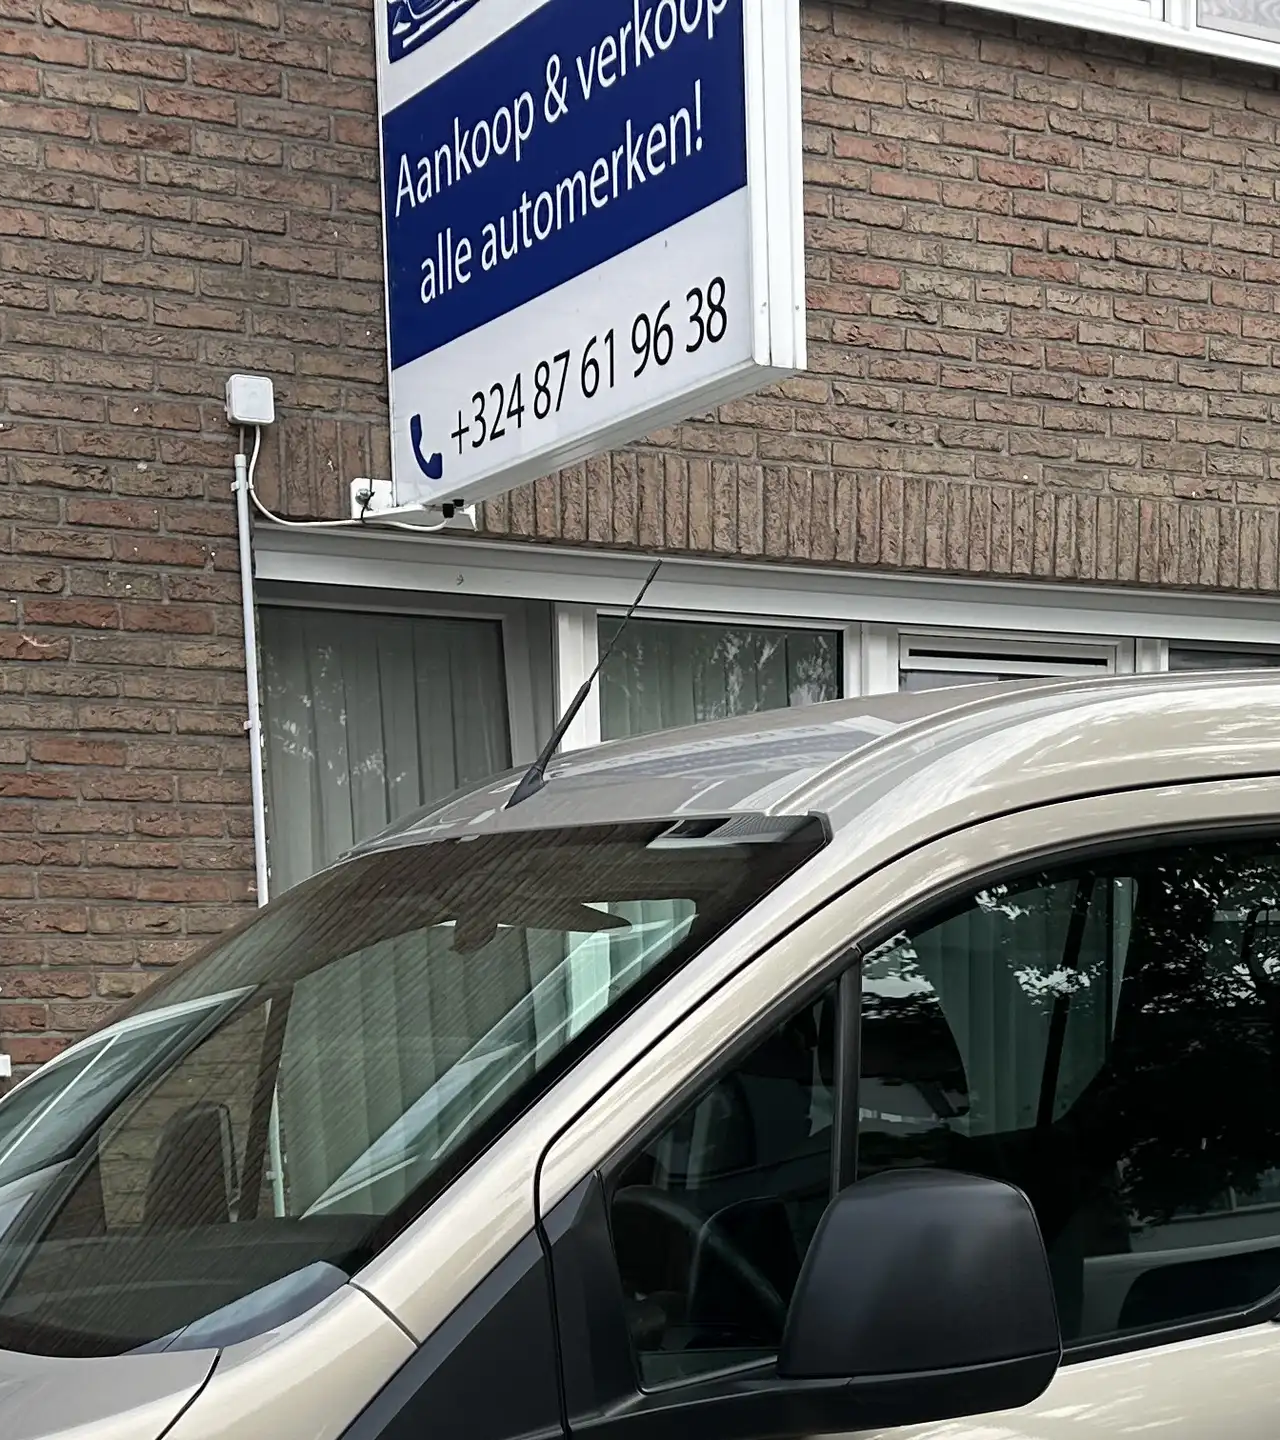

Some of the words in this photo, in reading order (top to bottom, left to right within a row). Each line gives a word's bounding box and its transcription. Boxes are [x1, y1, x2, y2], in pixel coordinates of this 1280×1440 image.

[395, 91, 534, 218] Aankoop
[543, 53, 569, 124] &
[575, 0, 728, 101] verkoop
[419, 226, 472, 304] alle
[480, 78, 704, 272] automerken!
[450, 372, 526, 456] +324
[533, 349, 571, 420] 87
[580, 328, 616, 399] 61
[631, 300, 674, 378] 96
[685, 276, 728, 355] 38
